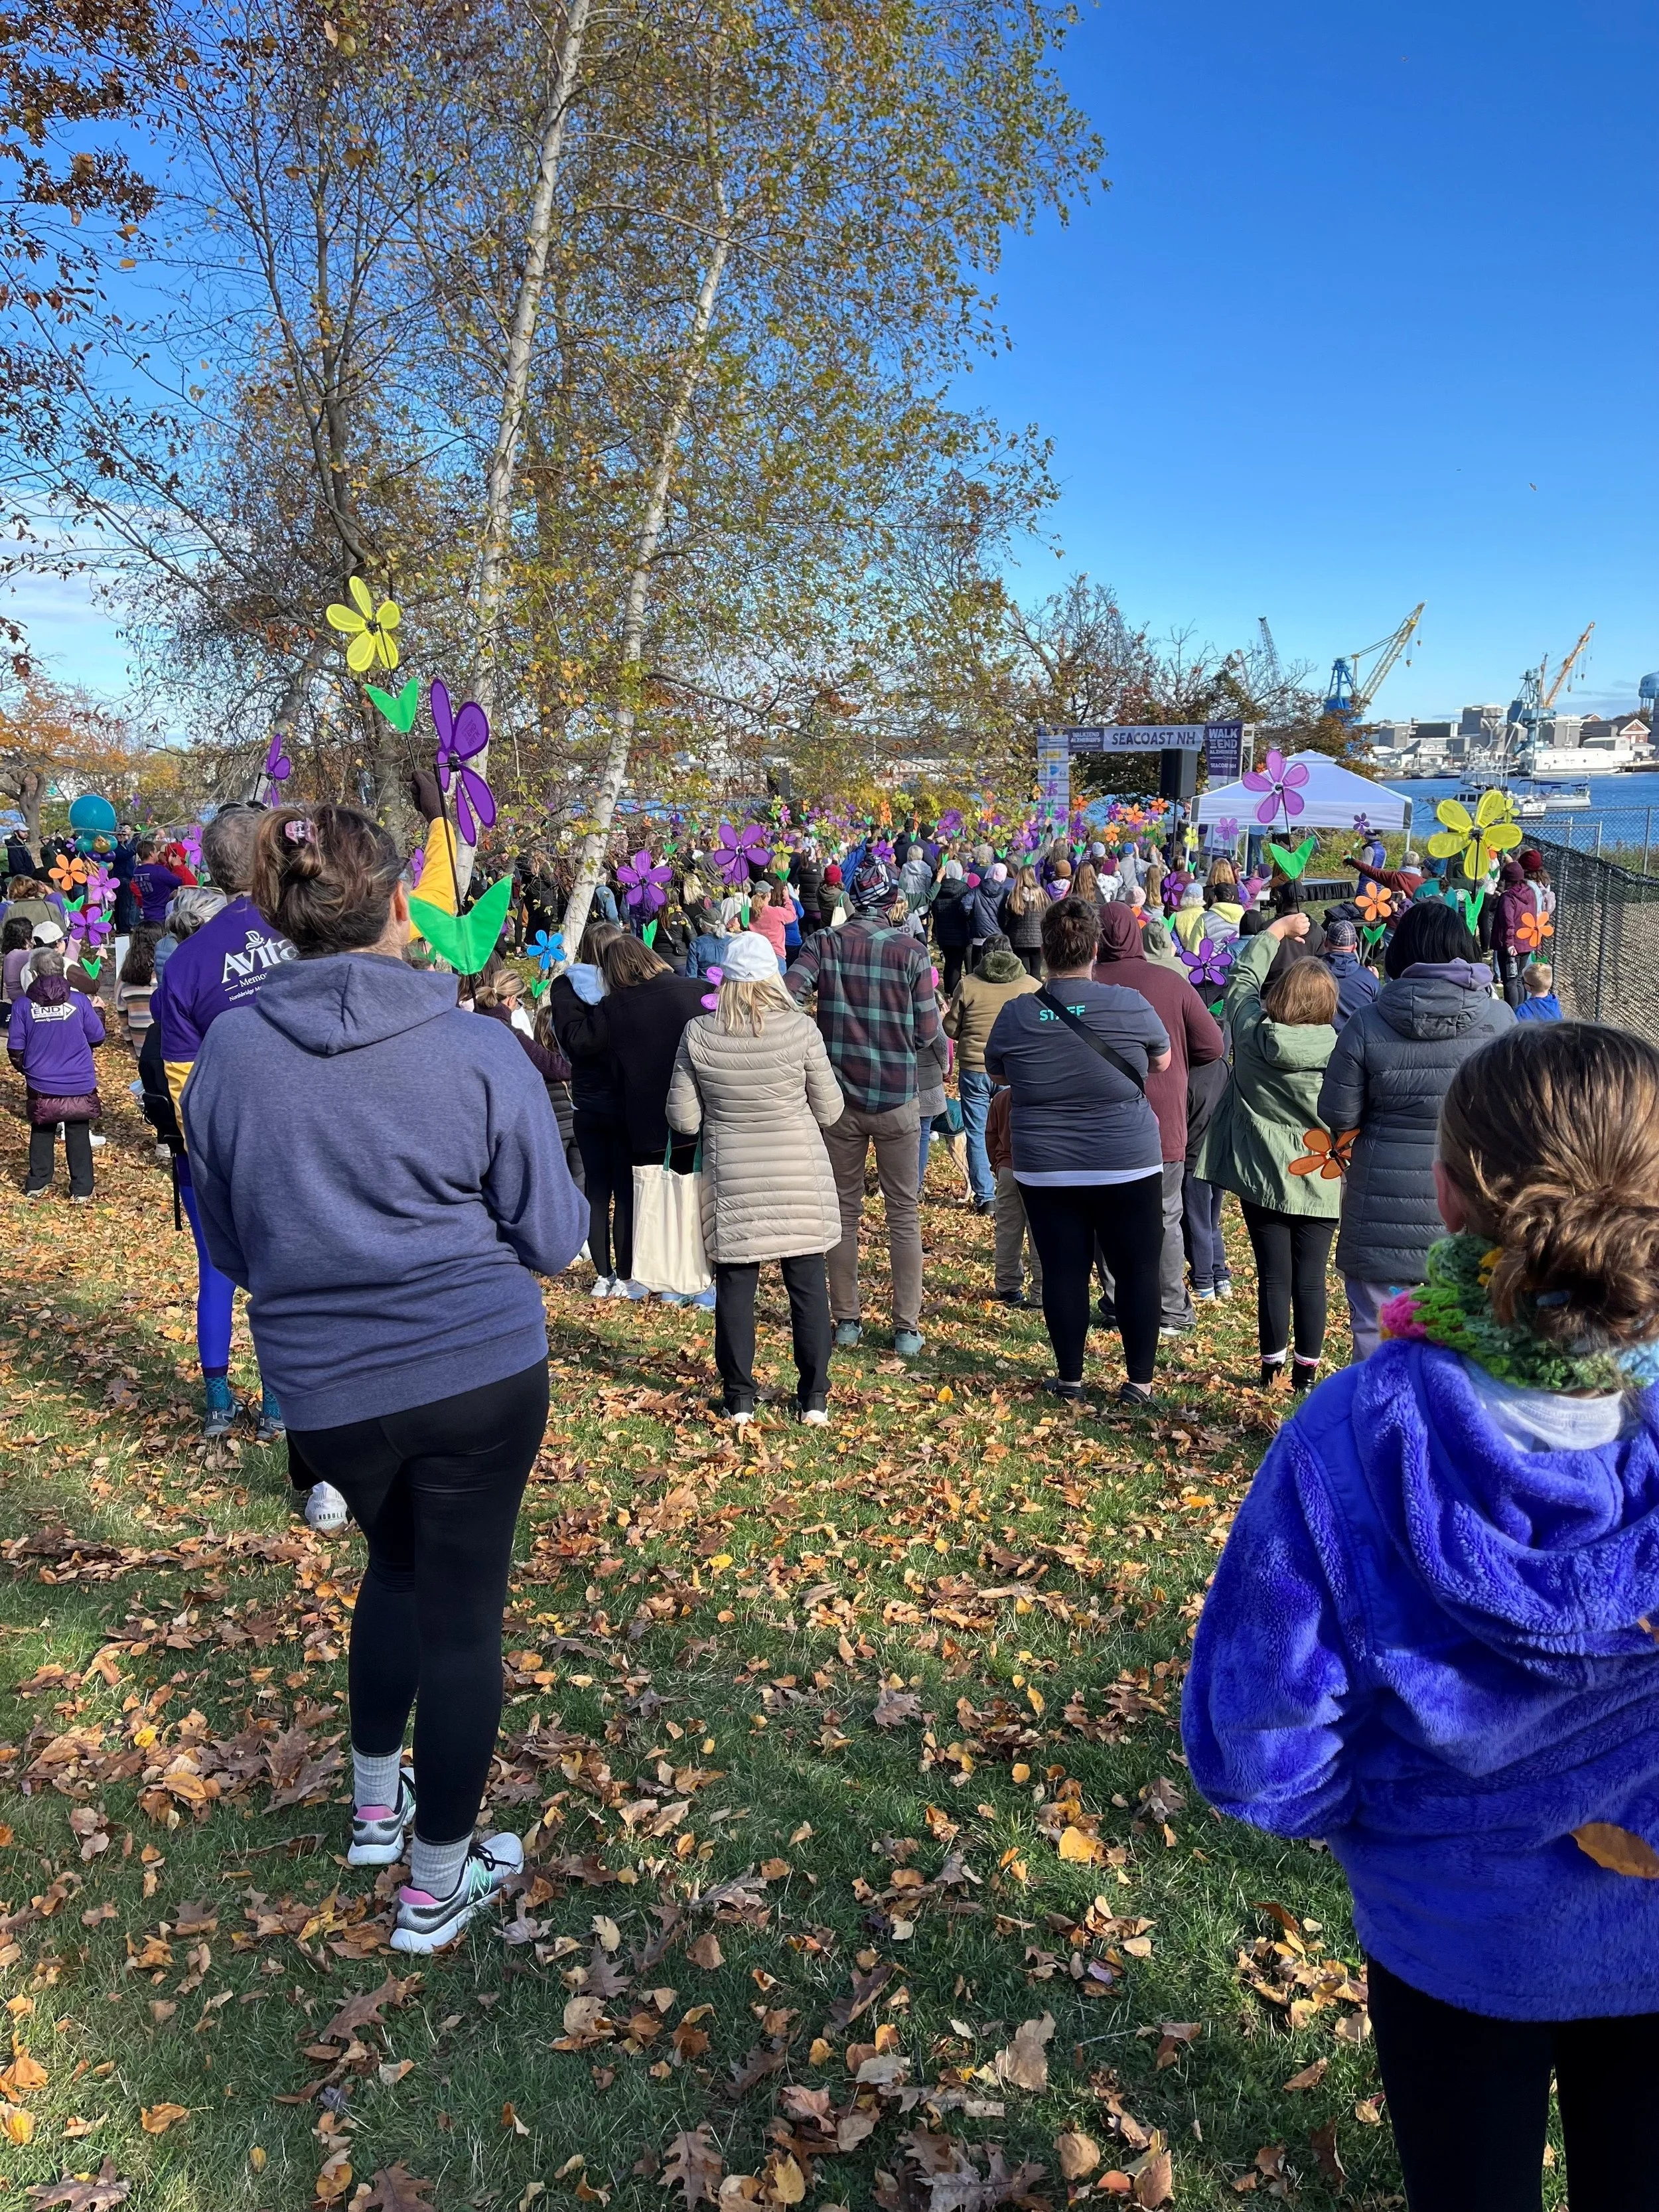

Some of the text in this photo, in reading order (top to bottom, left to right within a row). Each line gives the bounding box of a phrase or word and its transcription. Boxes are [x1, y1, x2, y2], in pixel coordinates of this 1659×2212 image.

[1112, 731, 1195, 745] SEACOAST NH
[1208, 729, 1238, 739] WALK
[1217, 739, 1238, 749] END
[222, 938, 298, 984] Avita
[239, 973, 267, 988] Memo
[1039, 1005, 1086, 1021] STFF
